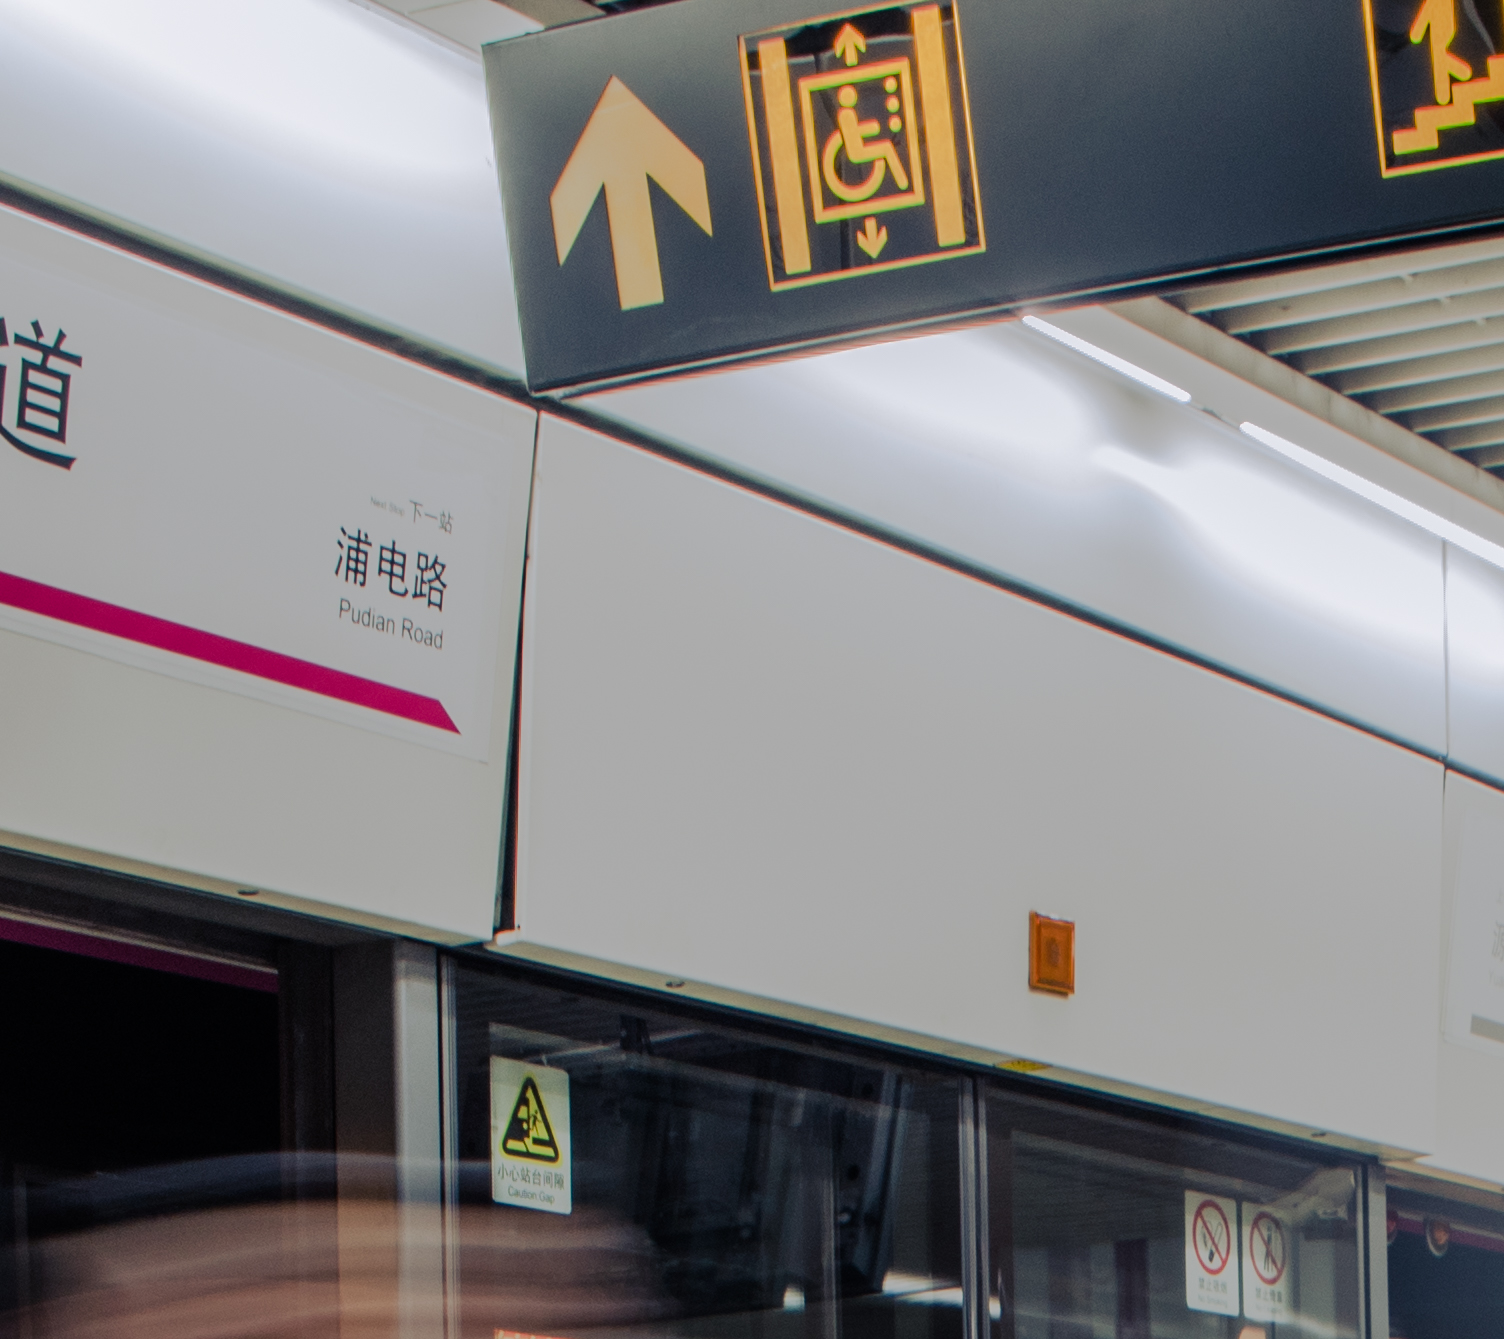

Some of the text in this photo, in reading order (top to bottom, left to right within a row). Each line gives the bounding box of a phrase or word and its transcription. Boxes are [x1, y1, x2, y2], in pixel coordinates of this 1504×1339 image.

[410, 499, 454, 535] 下一站
[335, 526, 448, 613] 浦电路
[339, 597, 445, 651] Pudian Road
